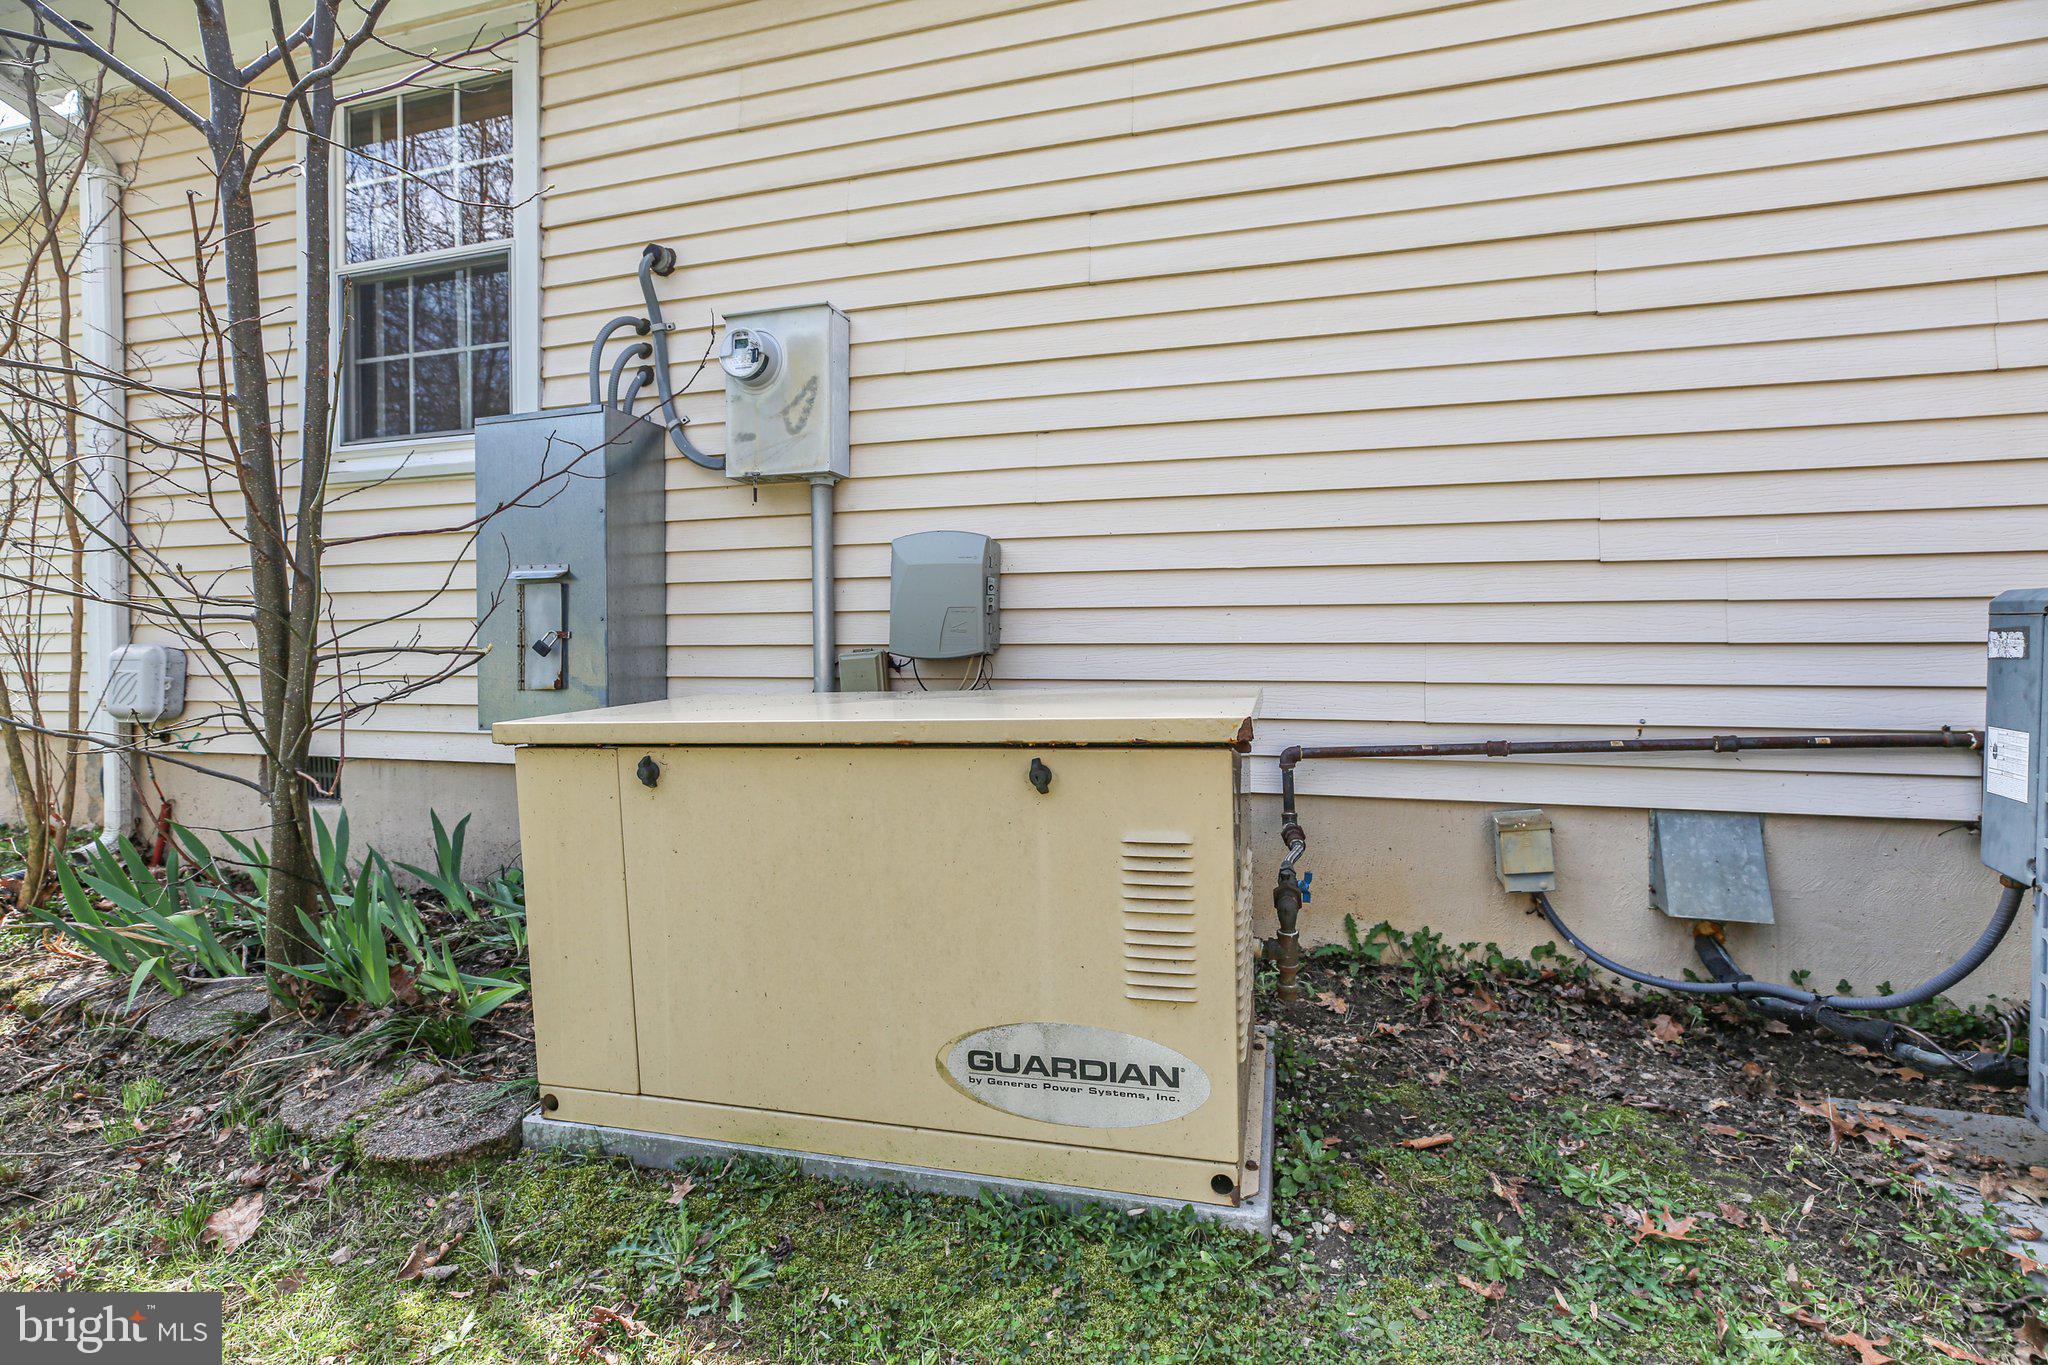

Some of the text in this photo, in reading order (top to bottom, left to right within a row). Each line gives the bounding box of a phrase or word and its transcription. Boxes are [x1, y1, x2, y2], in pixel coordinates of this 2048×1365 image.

[968, 1076, 1181, 1102] by Generac Power Systems, Inc.
